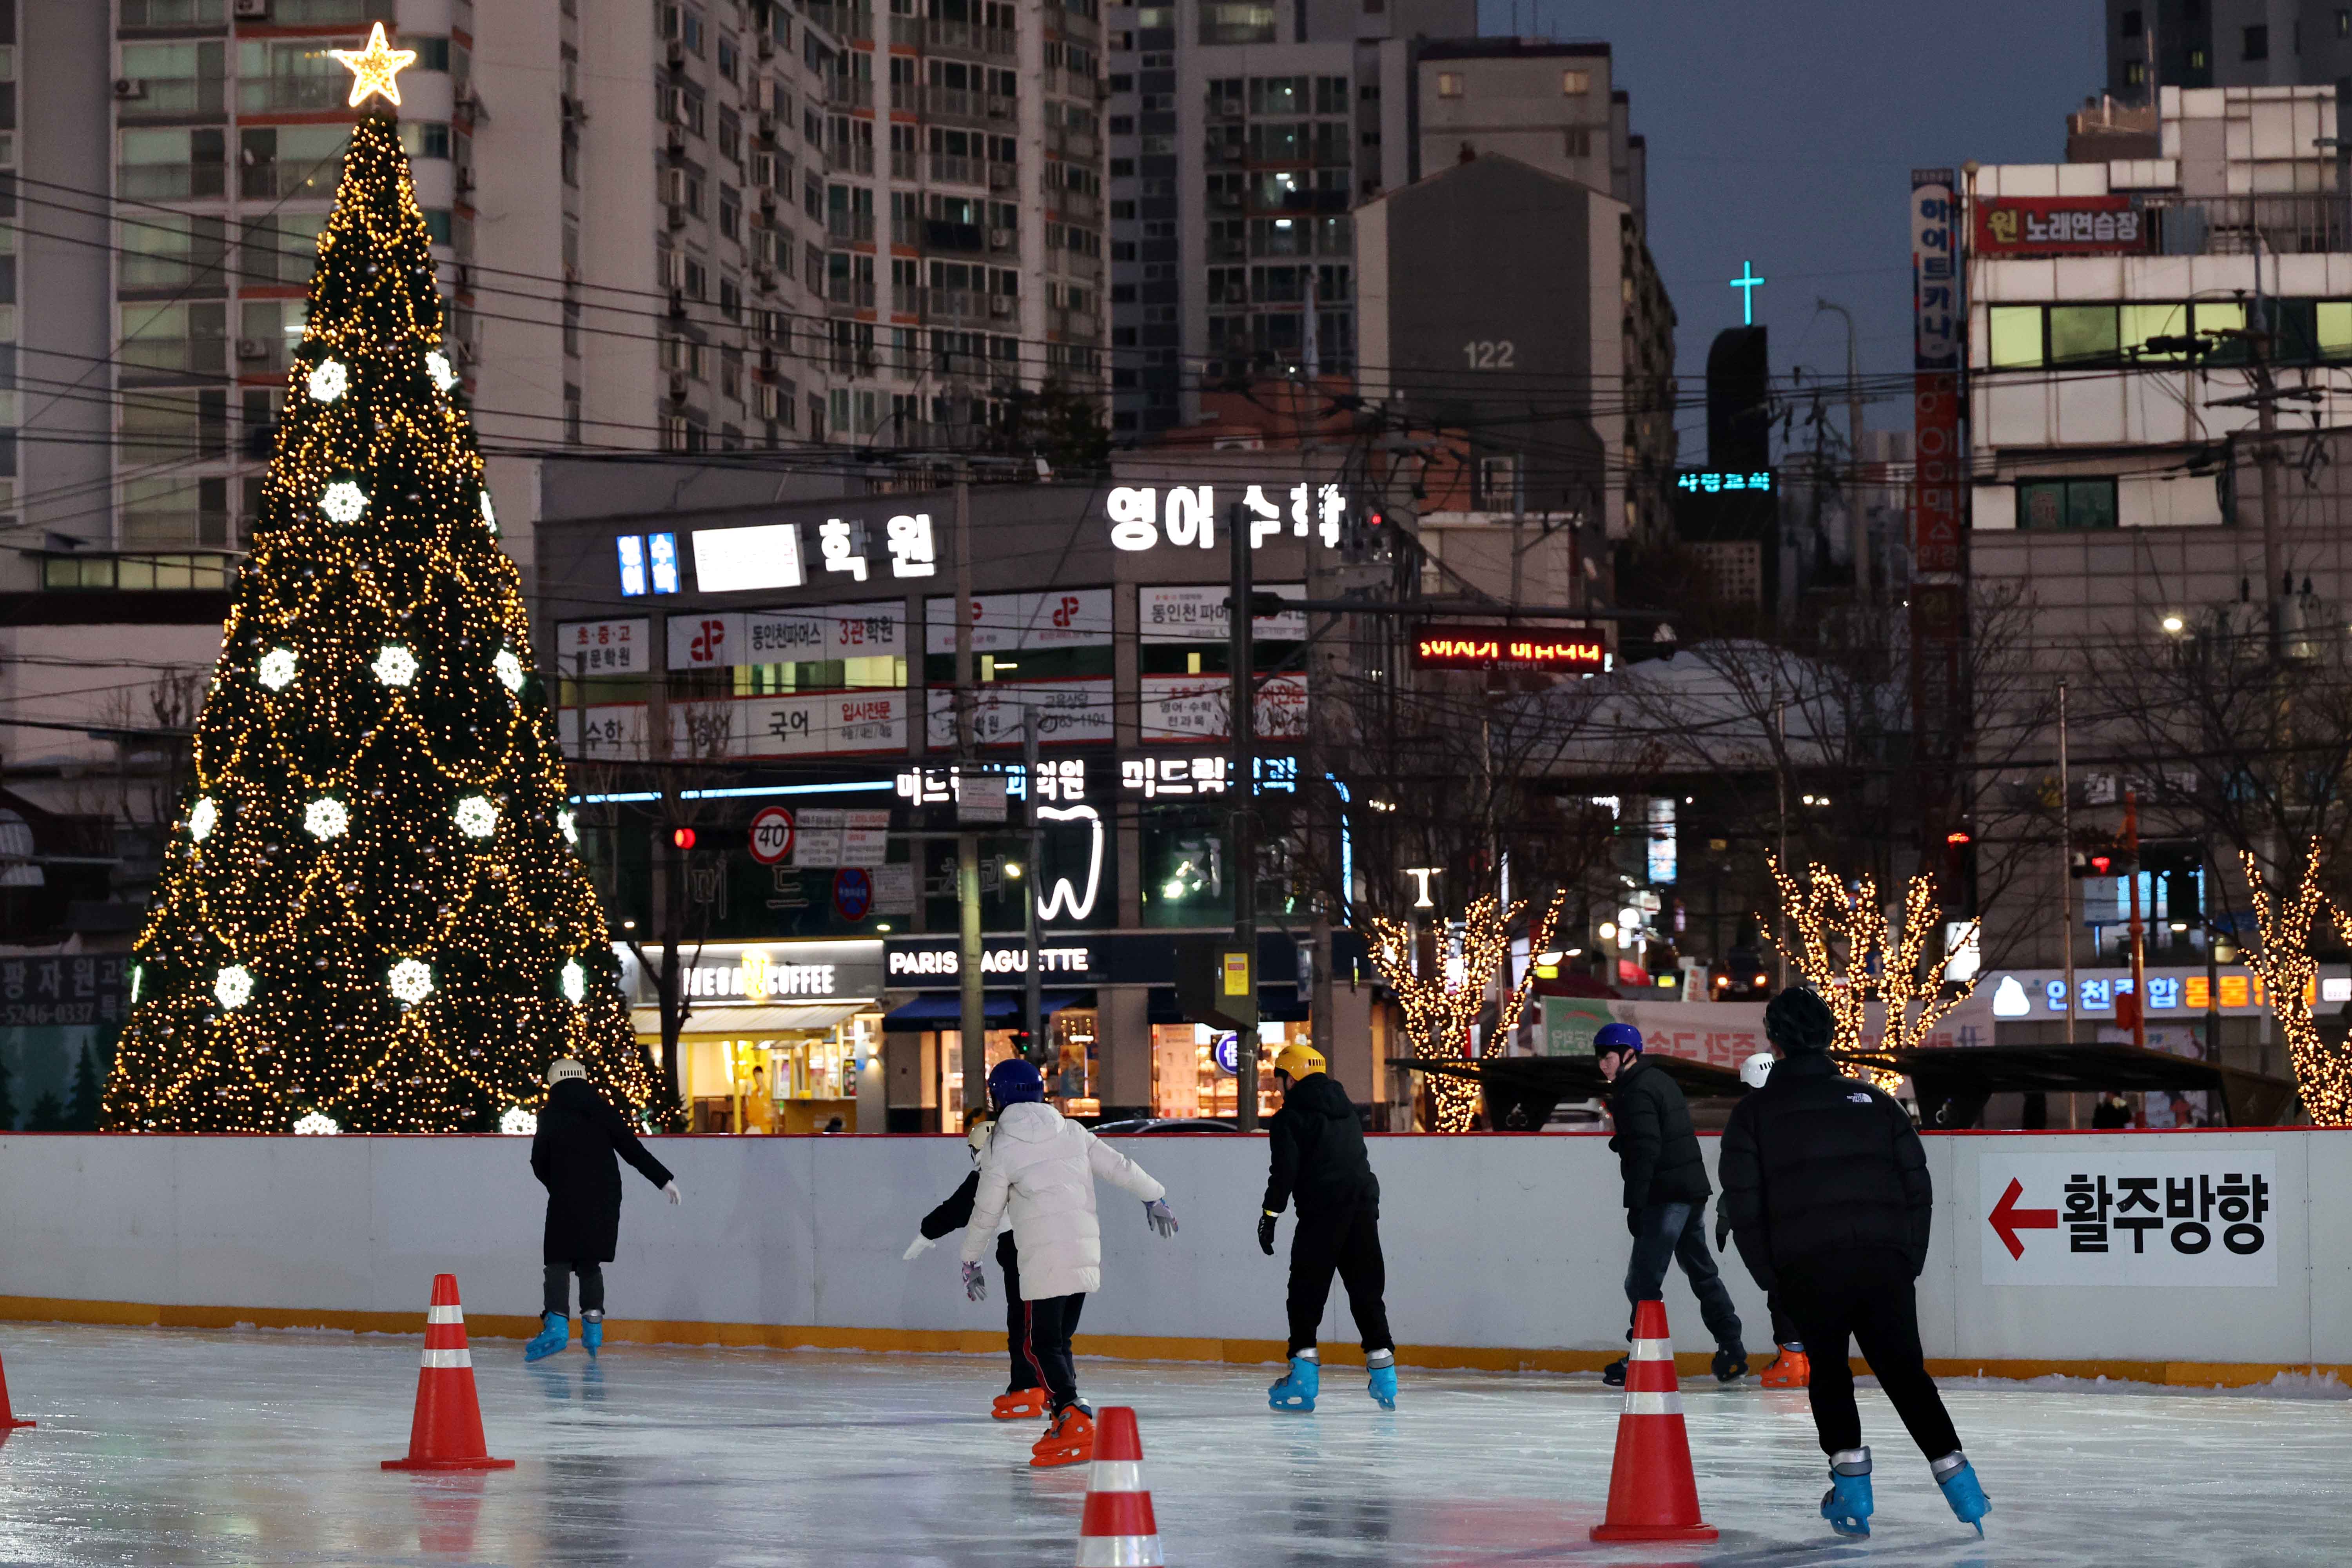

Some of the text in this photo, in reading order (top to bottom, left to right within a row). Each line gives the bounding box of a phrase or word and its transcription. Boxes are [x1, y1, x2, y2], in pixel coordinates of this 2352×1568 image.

[1987, 209, 2139, 243] 원 노래연습장
[1463, 340, 1515, 369] 122
[1106, 485, 1214, 551] 영어
[819, 514, 936, 582] 학원
[1152, 603, 1196, 624] 동인천
[1200, 603, 1230, 622] 파머
[752, 622, 821, 651] 동인천파머스
[579, 647, 630, 669] 문학원
[769, 710, 809, 742] 국어
[842, 701, 891, 722] 입시전문
[586, 718, 624, 751] 수학
[758, 824, 785, 847] 40
[890, 947, 1089, 974] PARIS AGUTTE
[683, 965, 835, 996] MEGA COFFEE
[2063, 1173, 2269, 1255] 활주방향
